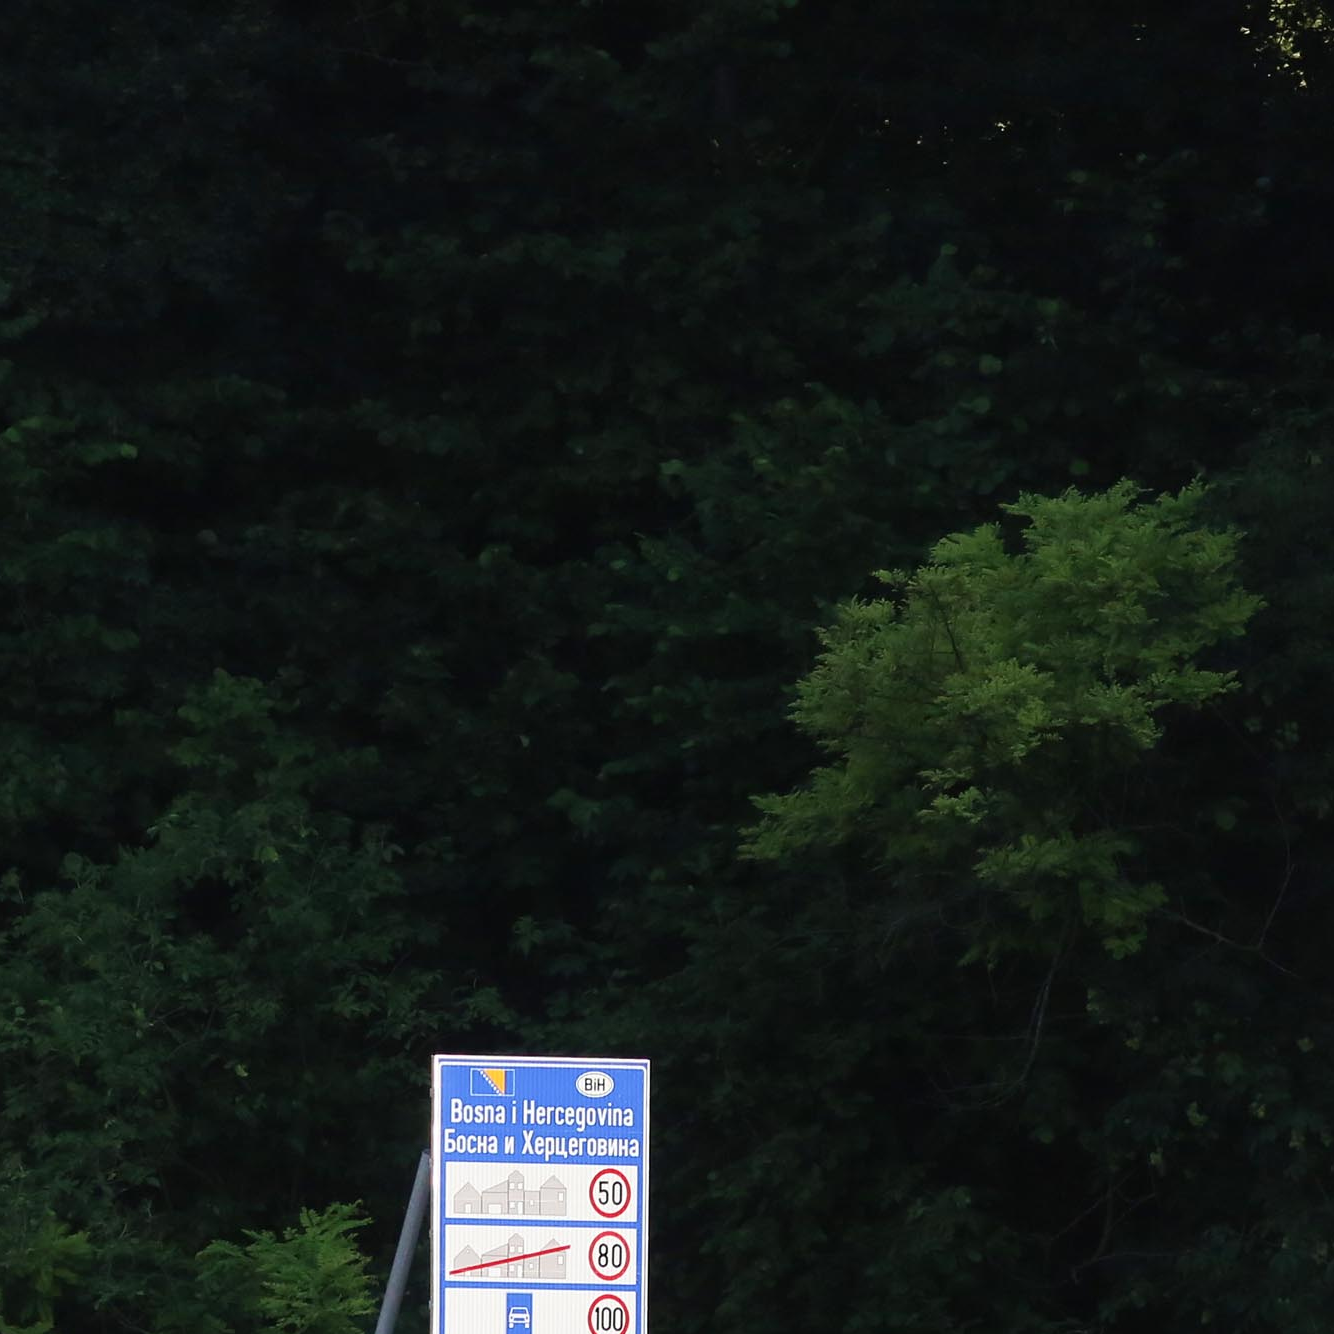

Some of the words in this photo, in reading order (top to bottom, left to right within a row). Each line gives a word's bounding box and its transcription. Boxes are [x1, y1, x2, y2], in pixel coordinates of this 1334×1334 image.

[584, 1077, 606, 1091] BiH
[450, 1098, 506, 1124] Bosna
[511, 1100, 517, 1124] i
[522, 1100, 634, 1132] Hercegovina
[444, 1129, 498, 1154] Босна
[504, 1135, 515, 1154] и
[522, 1130, 640, 1161] Херцеговина
[598, 1181, 623, 1206] 50
[597, 1243, 623, 1268] 80
[594, 1307, 624, 1332] 100
